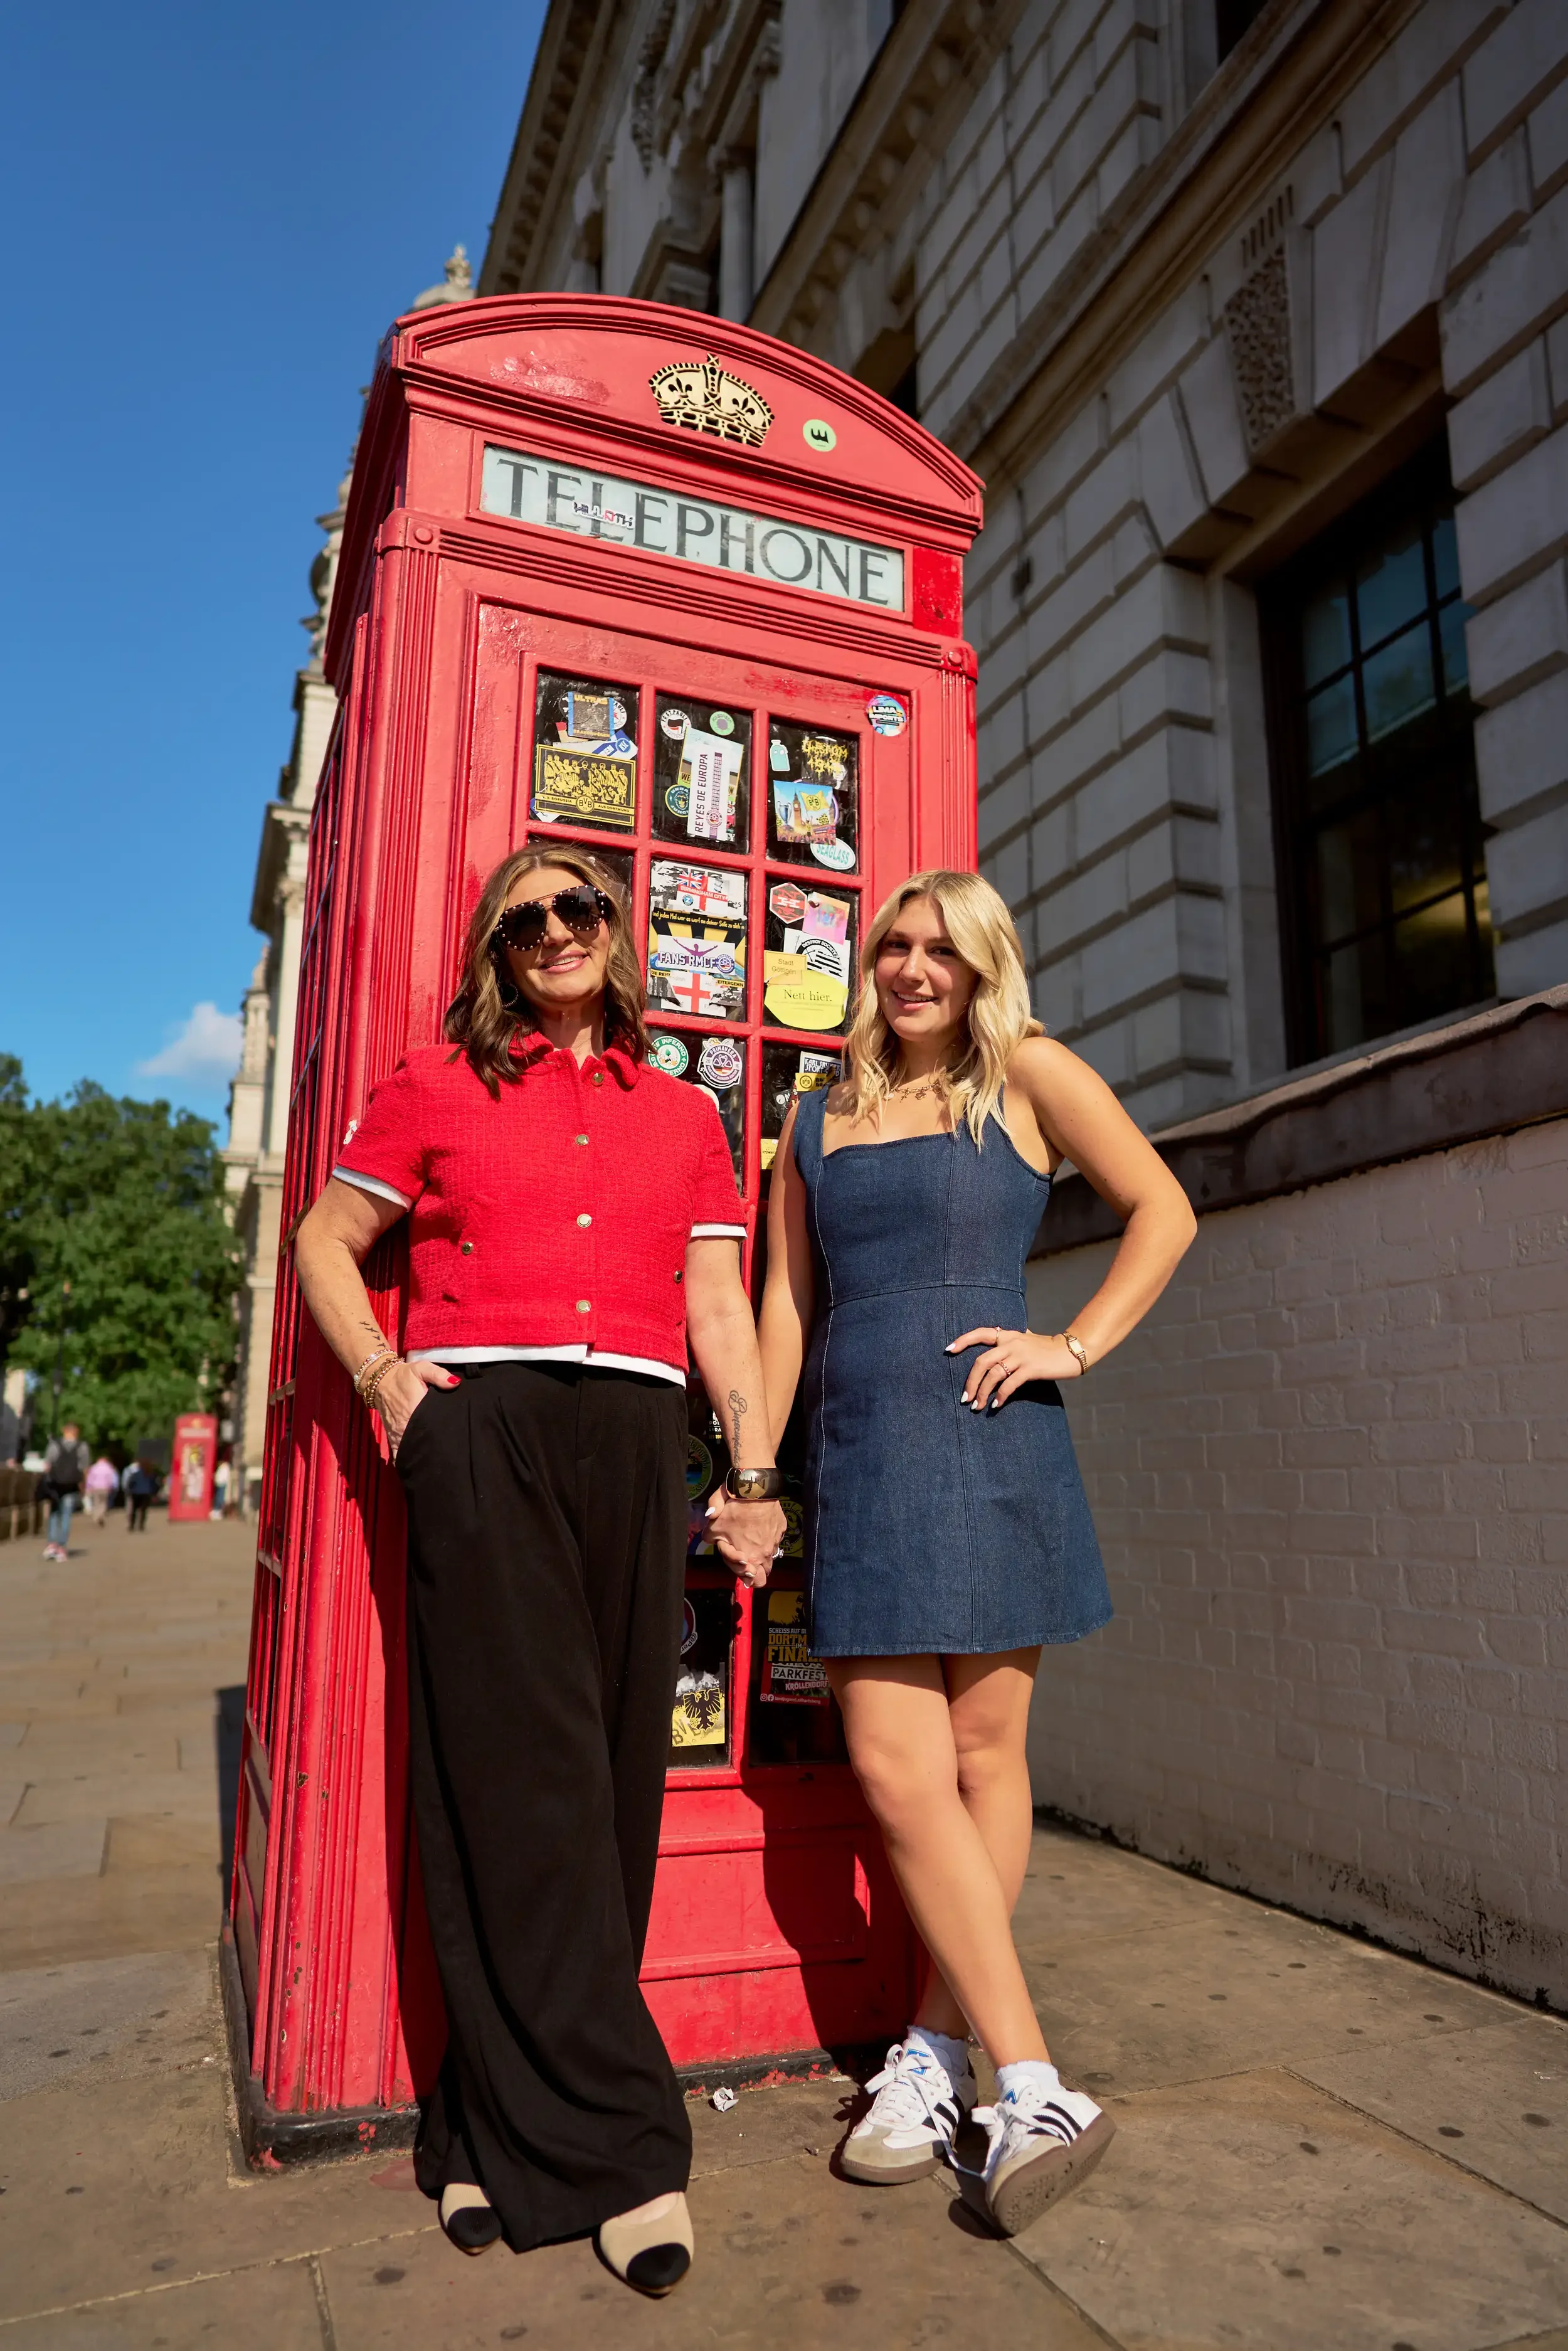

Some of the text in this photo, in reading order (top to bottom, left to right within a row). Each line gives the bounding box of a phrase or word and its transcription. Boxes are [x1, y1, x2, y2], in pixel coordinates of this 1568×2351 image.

[497, 459, 889, 605] TELEPHONE
[613, 701, 626, 714] AULI
[695, 753, 708, 832] REYES DE EUROPA
[579, 797, 593, 808] BVB
[817, 845, 850, 865] SEAGLASS
[680, 885, 714, 898] BIRMINGHAM
[802, 939, 837, 956] DESTROY SOCIETY
[659, 951, 686, 965] FANS
[688, 953, 717, 969] RMCF
[783, 989, 832, 1002] Nett hier.
[660, 1038, 687, 1056] INFERNO
[709, 1046, 737, 1058] PRIMAVERA
[772, 1667, 827, 1680] PARKFEST
